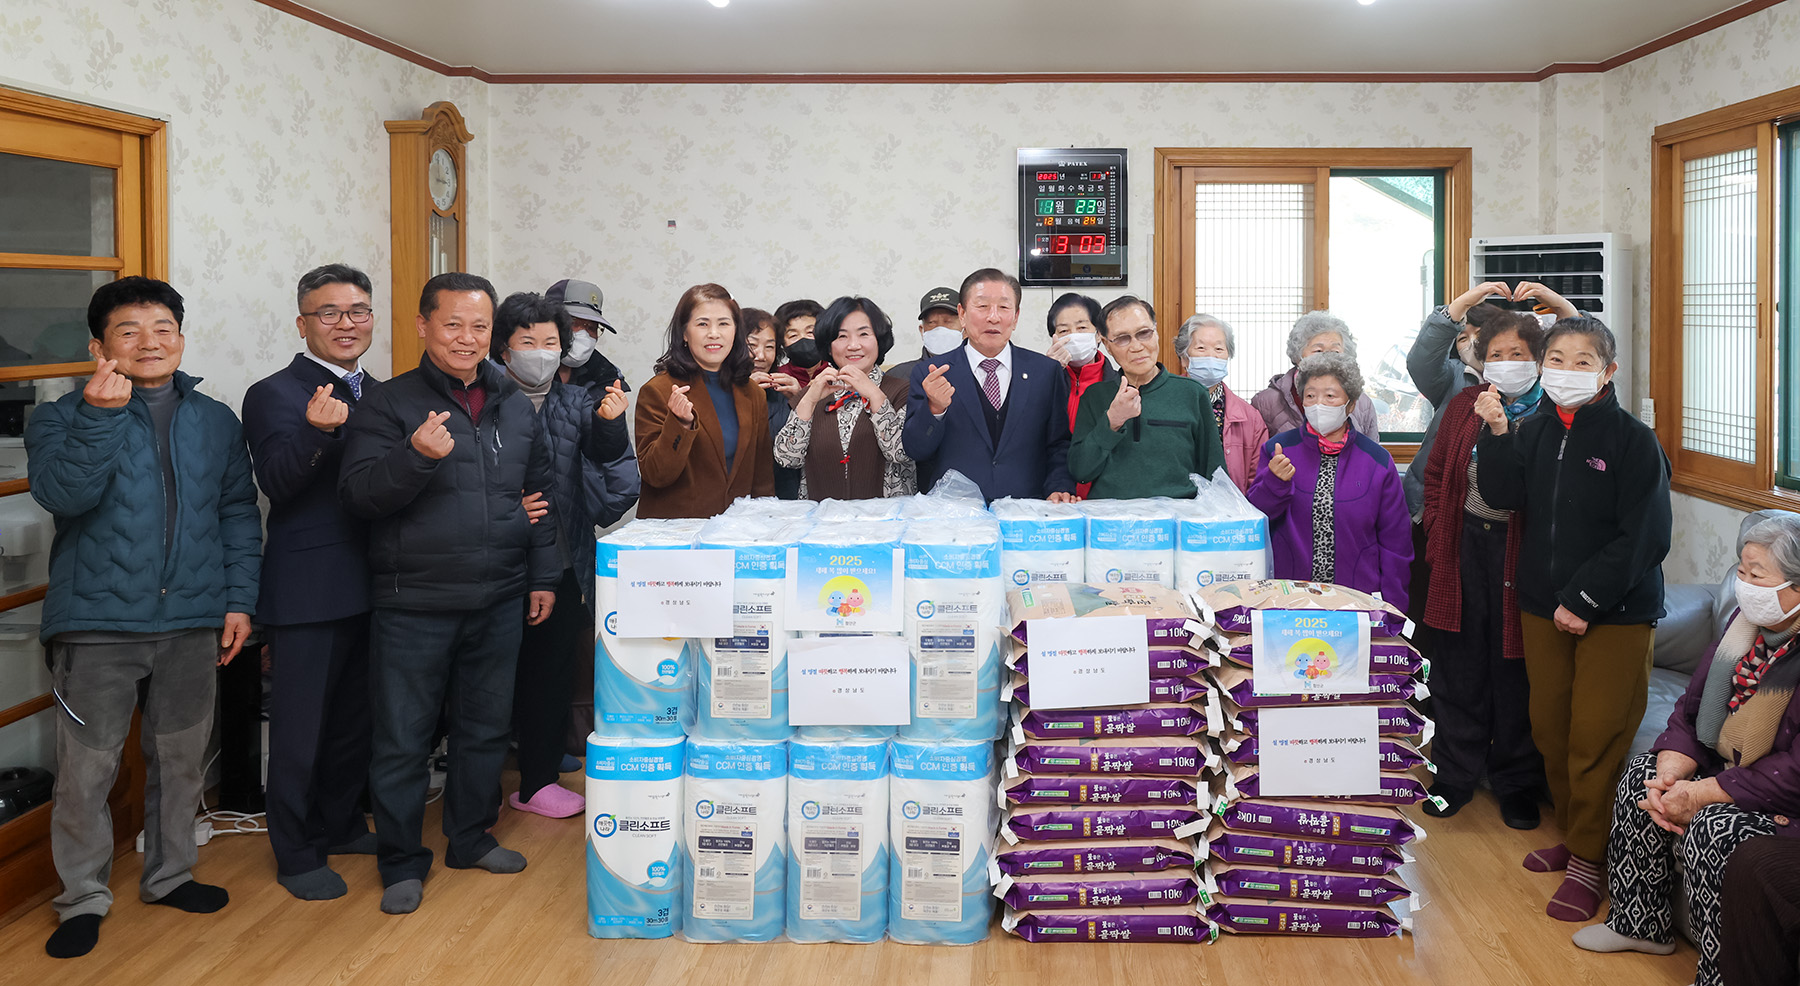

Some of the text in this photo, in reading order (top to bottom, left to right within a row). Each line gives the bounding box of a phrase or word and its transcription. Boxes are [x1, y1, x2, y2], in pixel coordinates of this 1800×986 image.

[1029, 535, 1046, 543] CCM
[1047, 534, 1062, 543] 인증
[1213, 535, 1230, 544] CCM
[752, 561, 767, 570] 인증
[829, 556, 862, 566] 2025
[1031, 573, 1068, 581] 클린소프트
[1124, 573, 1160, 581] 클린소프트
[1215, 573, 1251, 581] 클린소프트
[1295, 617, 1328, 628] 2025
[1388, 654, 1409, 666] 10kg
[1104, 722, 1136, 734] 골짝쌀
[620, 763, 639, 771] CCM
[640, 763, 655, 771] 인증
[716, 761, 736, 770] CCM
[737, 762, 753, 771] 인증
[1101, 760, 1134, 771] 골짝쌀
[1174, 757, 1195, 767] 10kg
[821, 763, 841, 771] CCM
[842, 763, 859, 772] 인증
[920, 763, 941, 771] CCM
[942, 763, 958, 772] 인증
[1090, 792, 1122, 802] 골짝쌀
[716, 805, 757, 815] 클린소프트
[822, 806, 863, 815] 클린소프트
[922, 806, 963, 816] 클린소프트
[1298, 813, 1330, 827] 골짝쌀
[619, 820, 670, 831] 클린소프트
[1094, 824, 1126, 836] 골짝쌀
[1294, 855, 1327, 866] 골짝쌀
[1084, 861, 1117, 871] 골짝쌀
[1300, 888, 1333, 900] 골짝쌀
[1090, 895, 1122, 905] 골짝쌀
[1173, 925, 1194, 937] 10kg
[1289, 921, 1322, 932] 골짝쌀
[1098, 929, 1131, 939] 골짝쌀
